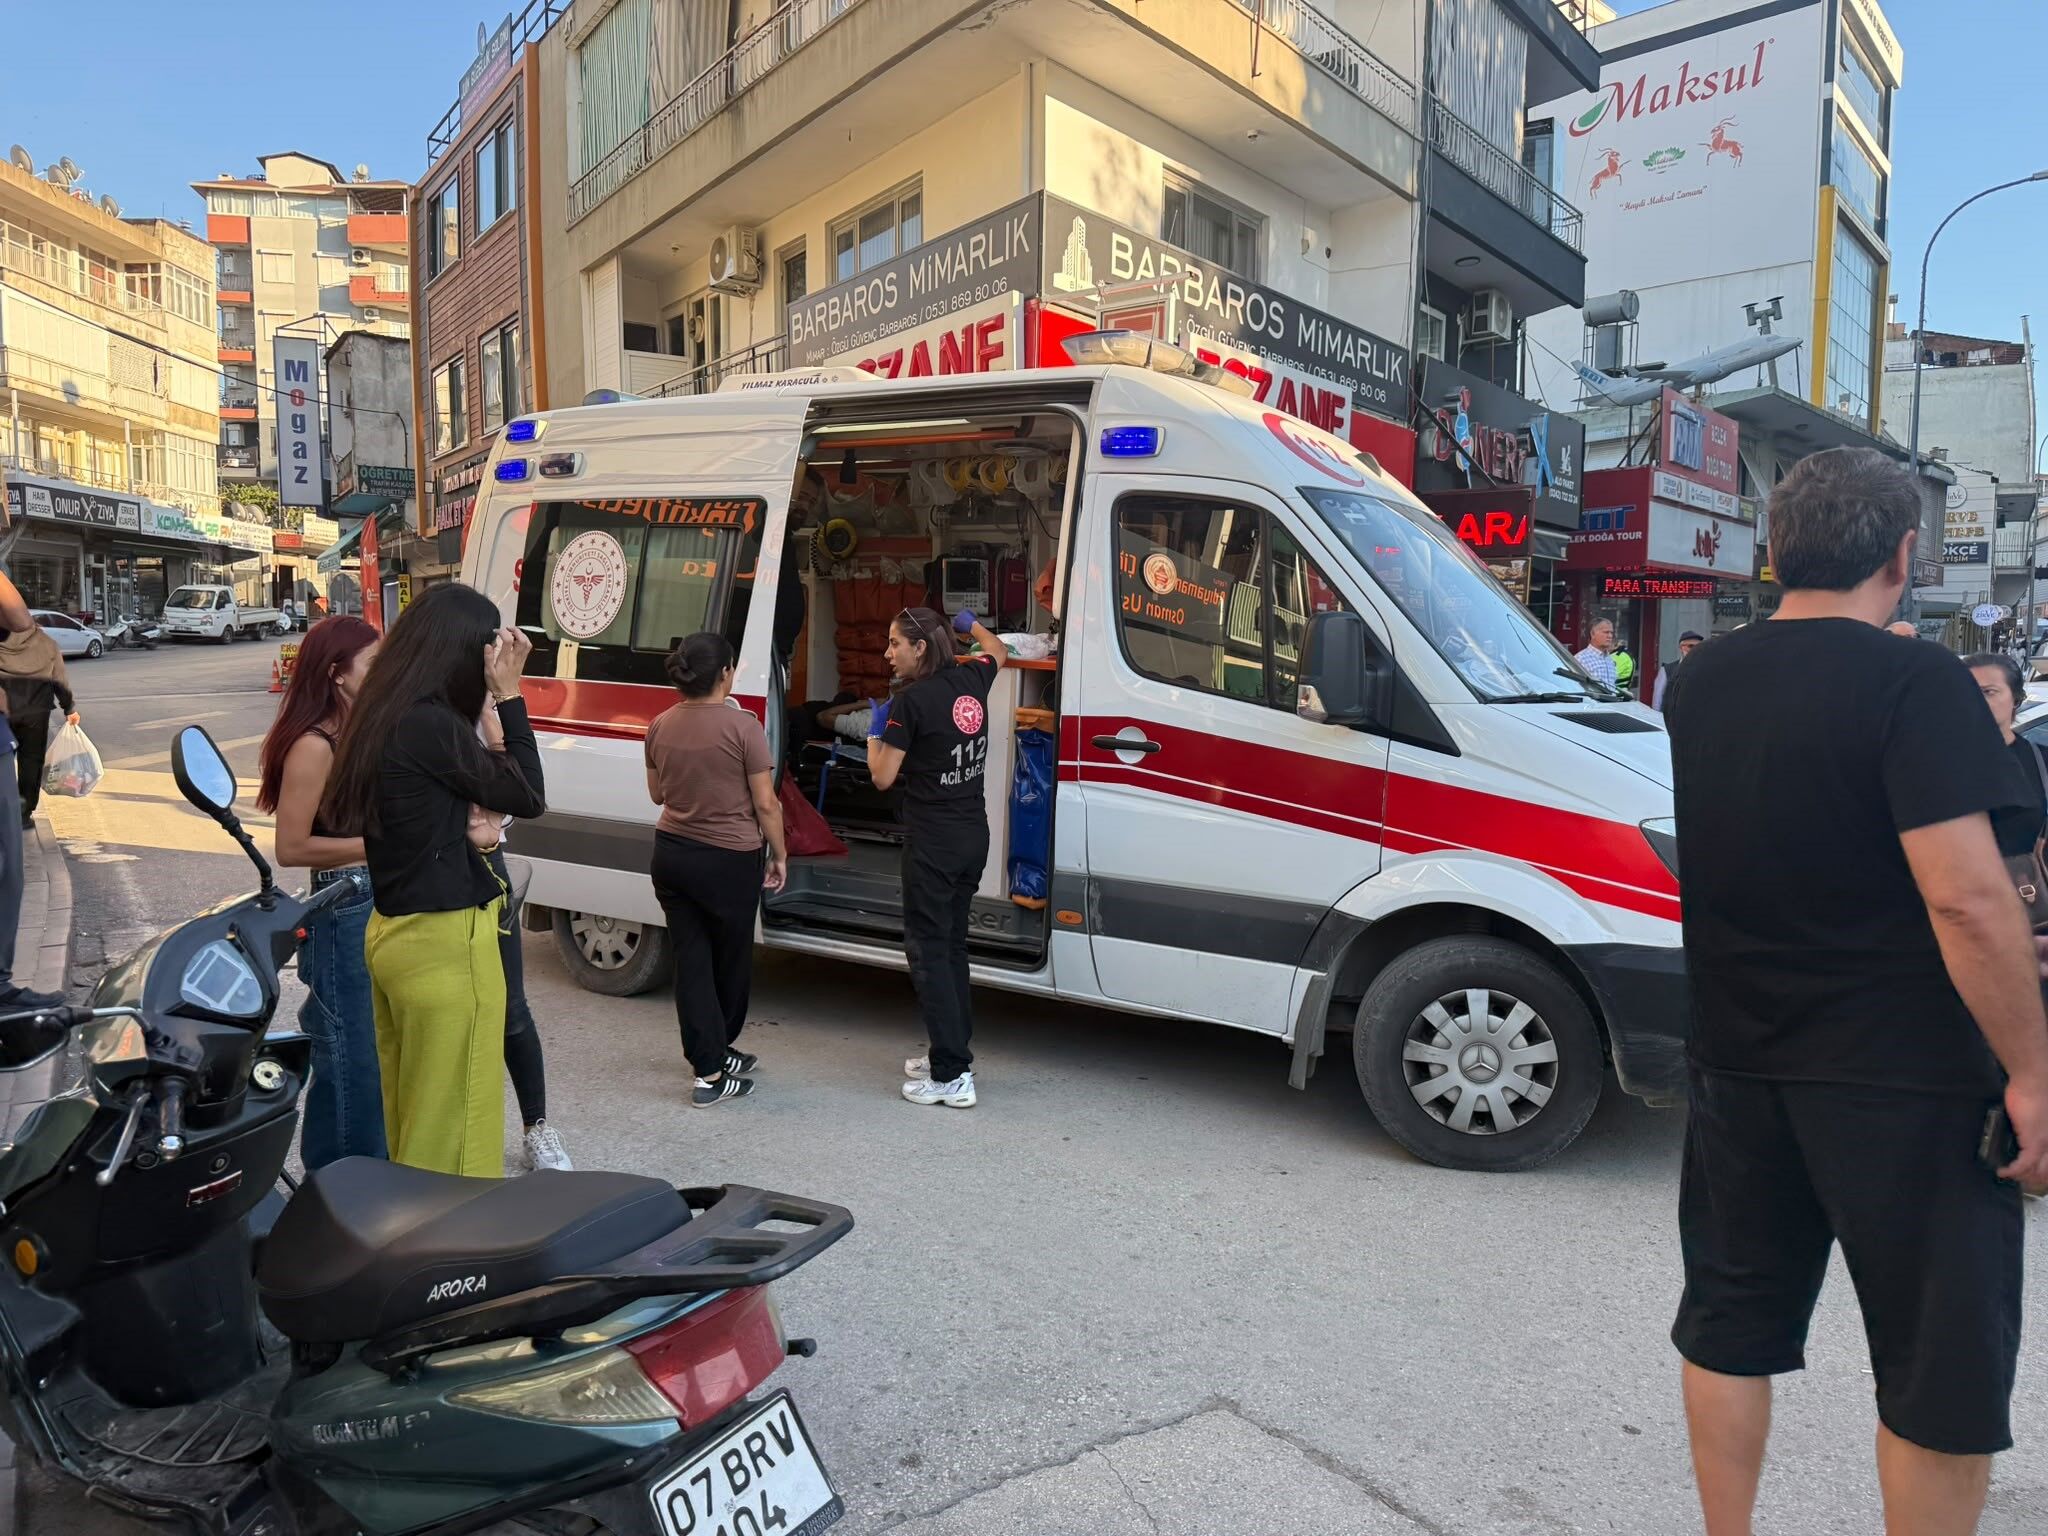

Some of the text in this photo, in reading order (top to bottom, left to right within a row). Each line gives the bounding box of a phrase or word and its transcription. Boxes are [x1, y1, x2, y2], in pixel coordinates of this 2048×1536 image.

[1569, 41, 1765, 137] Maksul
[925, 304, 948, 321] 0531
[951, 290, 972, 311] 869
[974, 283, 990, 300] 80
[992, 276, 1008, 294] 06
[1111, 233, 1285, 339] BARBAROS
[792, 272, 897, 345] BARBAROS
[741, 379, 774, 390] YILMAZ
[1339, 374, 1358, 394] 869
[1360, 383, 1373, 398] 80
[1374, 387, 1387, 403] 06
[54, 496, 81, 517] ONUR
[1569, 534, 1586, 544] LEK
[1617, 531, 1643, 541] TOUR
[1604, 578, 1640, 593] PARA
[951, 736, 987, 767] 112
[940, 767, 963, 785] ACİL
[427, 1274, 487, 1303] ARORA
[667, 1410, 795, 1536] 07 BRV
[716, 1489, 787, 1536] 04
